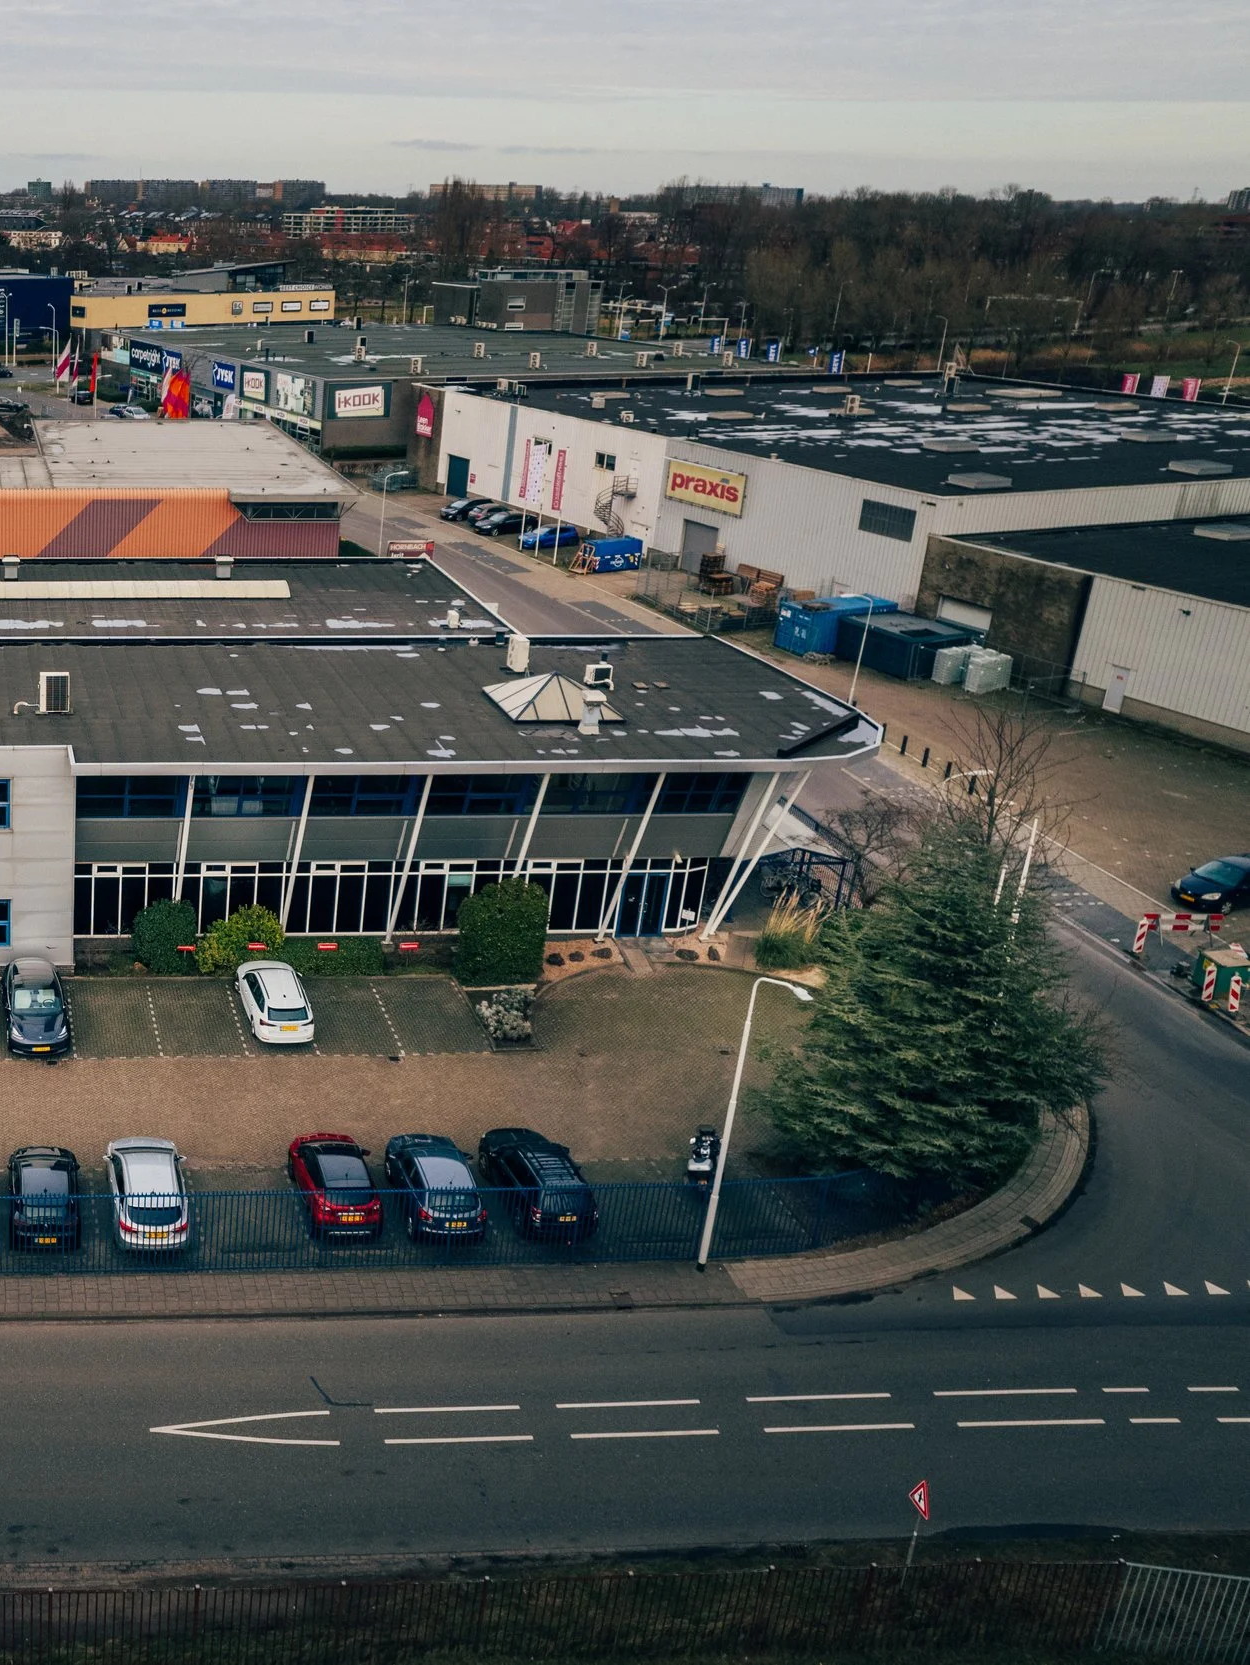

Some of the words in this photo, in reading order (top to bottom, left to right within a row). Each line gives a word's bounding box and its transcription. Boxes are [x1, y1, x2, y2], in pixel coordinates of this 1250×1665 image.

[131, 347, 161, 367] carpetright
[166, 355, 181, 369] JYSK
[216, 366, 234, 383] JYSK
[671, 472, 739, 503] praxis
[390, 543, 427, 551] HORNBACH
